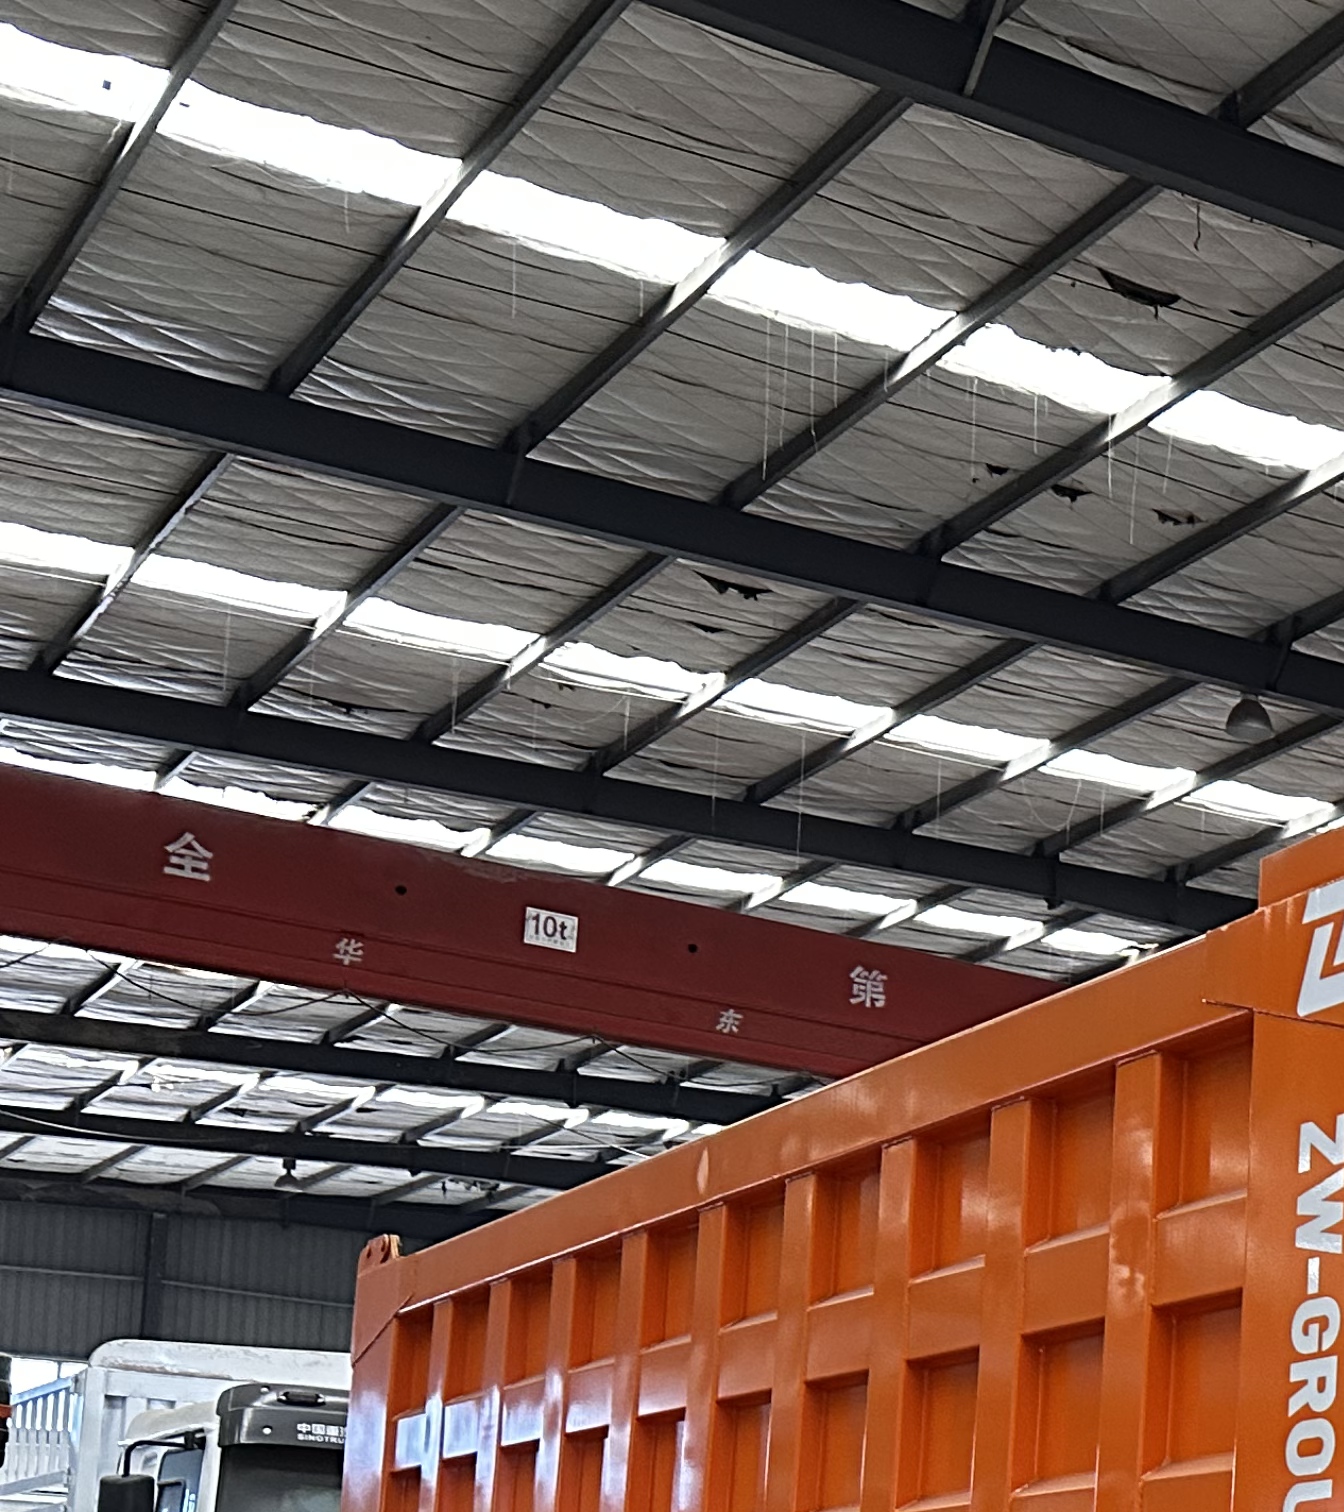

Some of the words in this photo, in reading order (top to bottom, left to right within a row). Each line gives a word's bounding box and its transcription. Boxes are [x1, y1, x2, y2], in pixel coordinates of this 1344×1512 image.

[163, 832, 213, 882] 全
[849, 965, 888, 1008] 第
[532, 913, 567, 940] 10t
[333, 938, 364, 966] 华
[716, 1009, 743, 1033] 东
